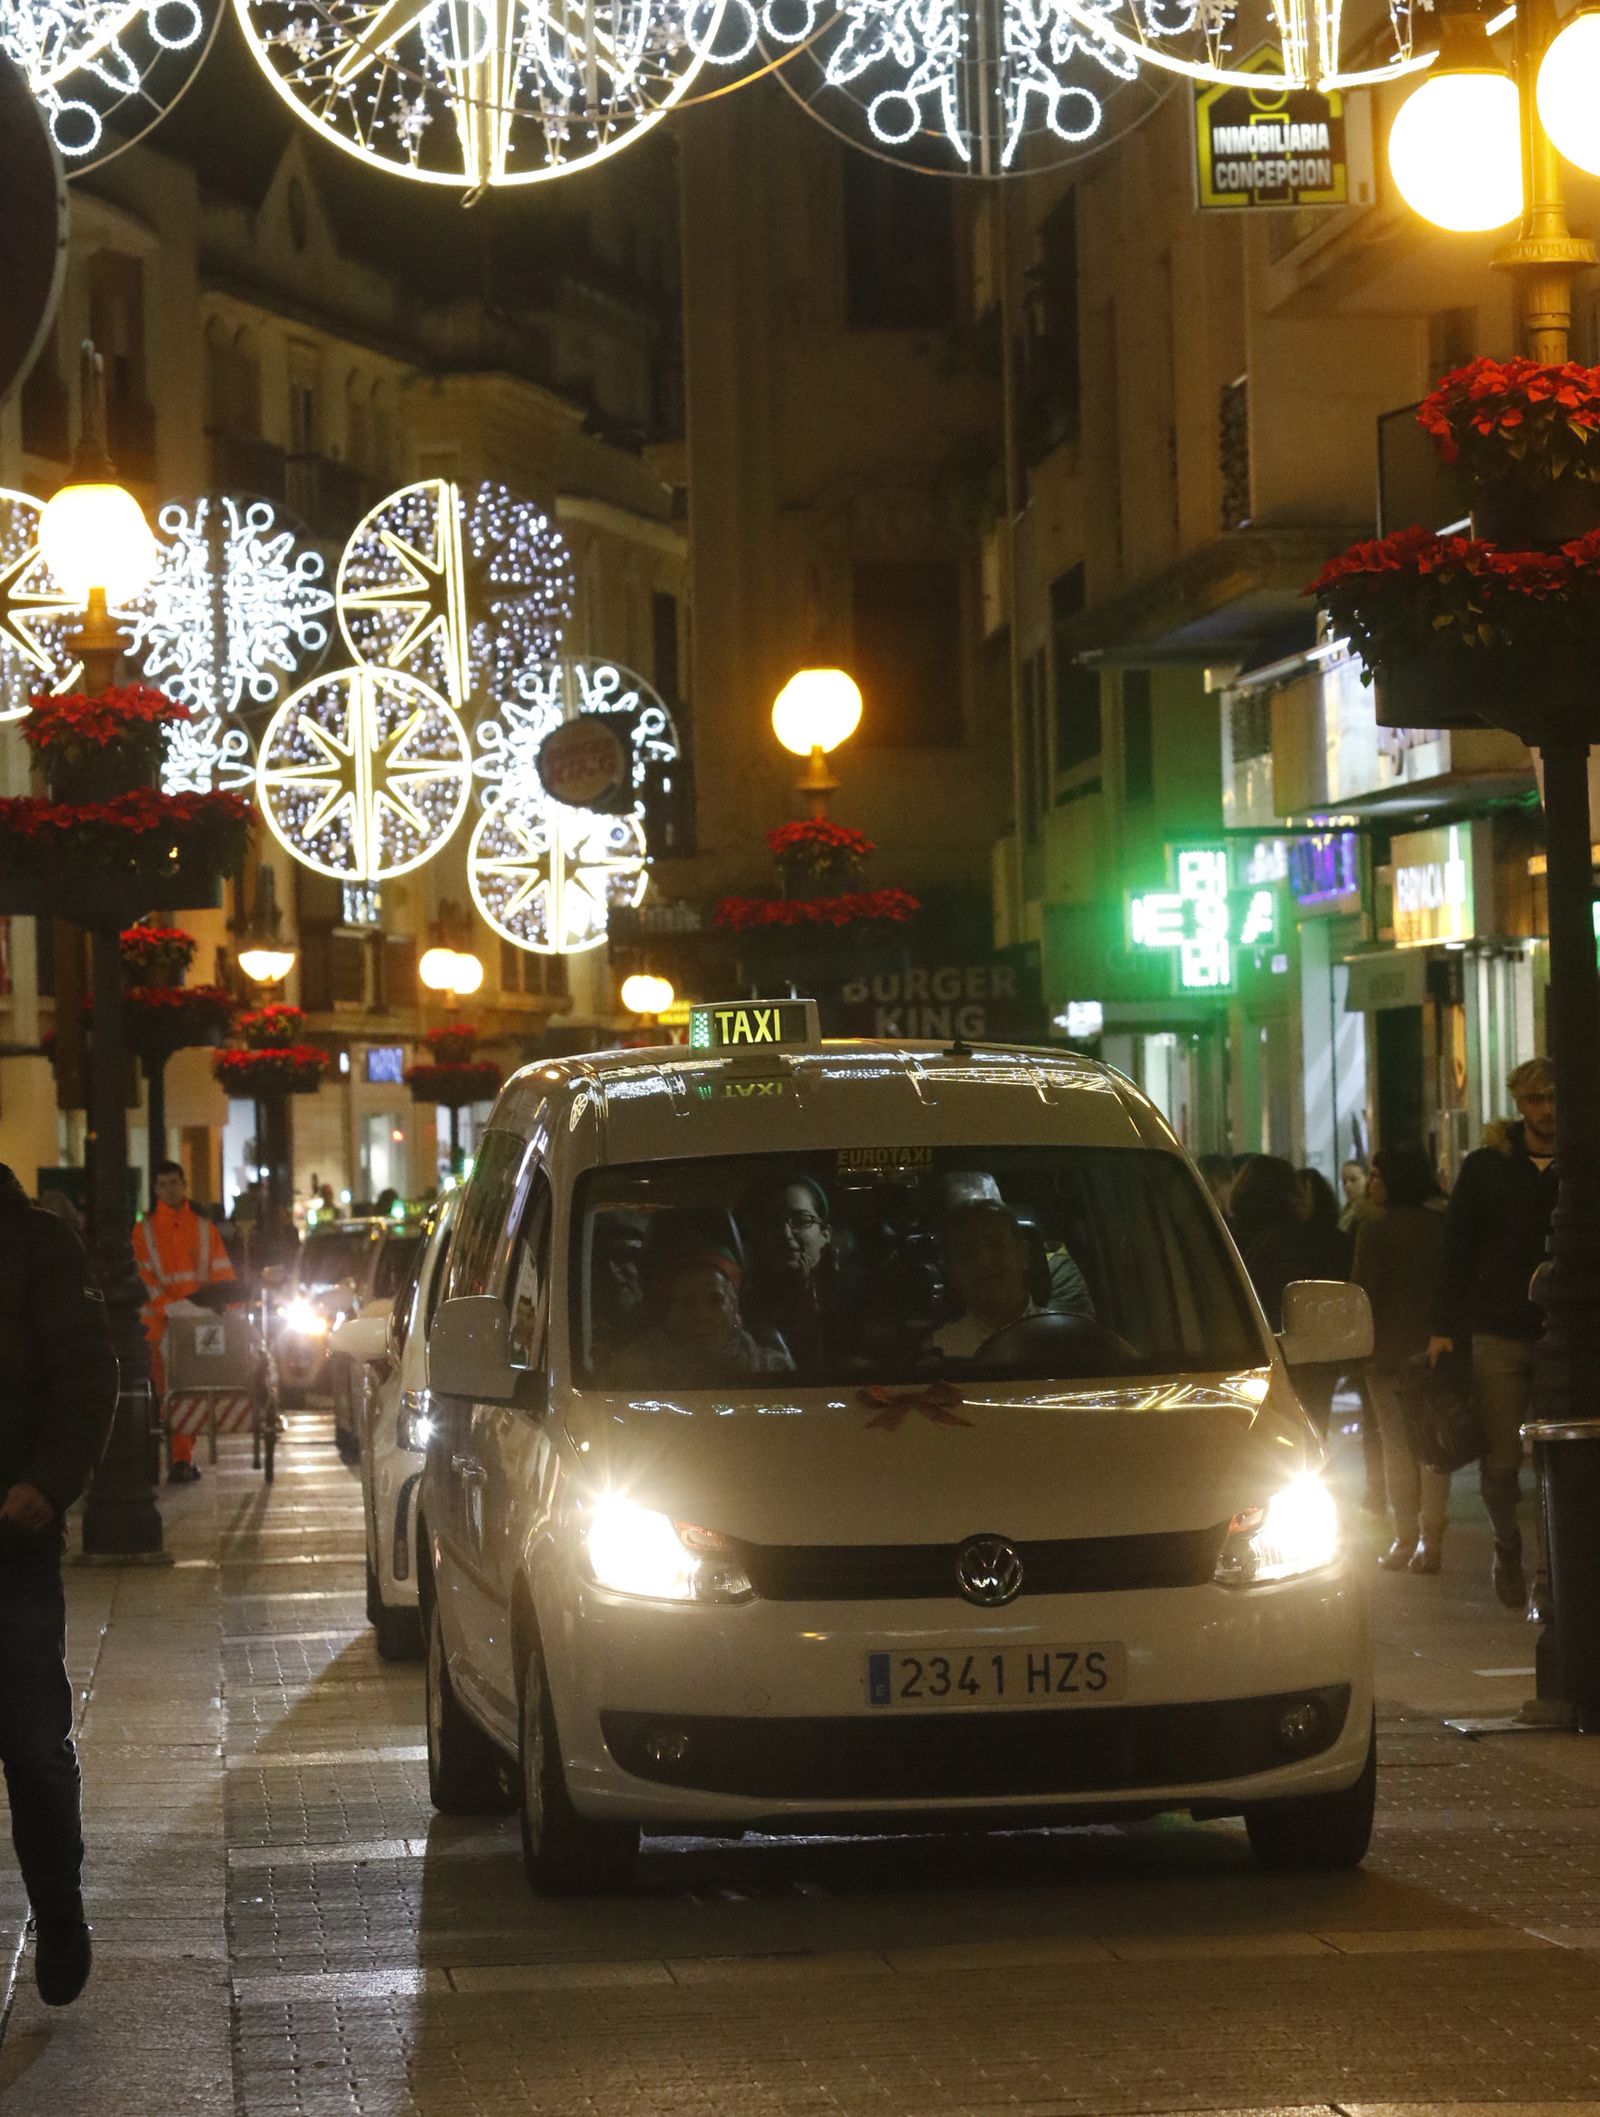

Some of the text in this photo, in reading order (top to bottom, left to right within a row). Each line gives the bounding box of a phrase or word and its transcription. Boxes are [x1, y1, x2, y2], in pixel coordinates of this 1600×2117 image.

[1213, 123, 1330, 154] INMOBILIARIA
[1215, 159, 1331, 189] CONCEPCION
[843, 966, 1016, 1003] BURGER
[715, 1009, 781, 1044] TAXI
[875, 1005, 985, 1038] KING
[837, 1146, 932, 1165] EUROTAXI
[901, 1652, 1108, 1697] 2341 HZS
